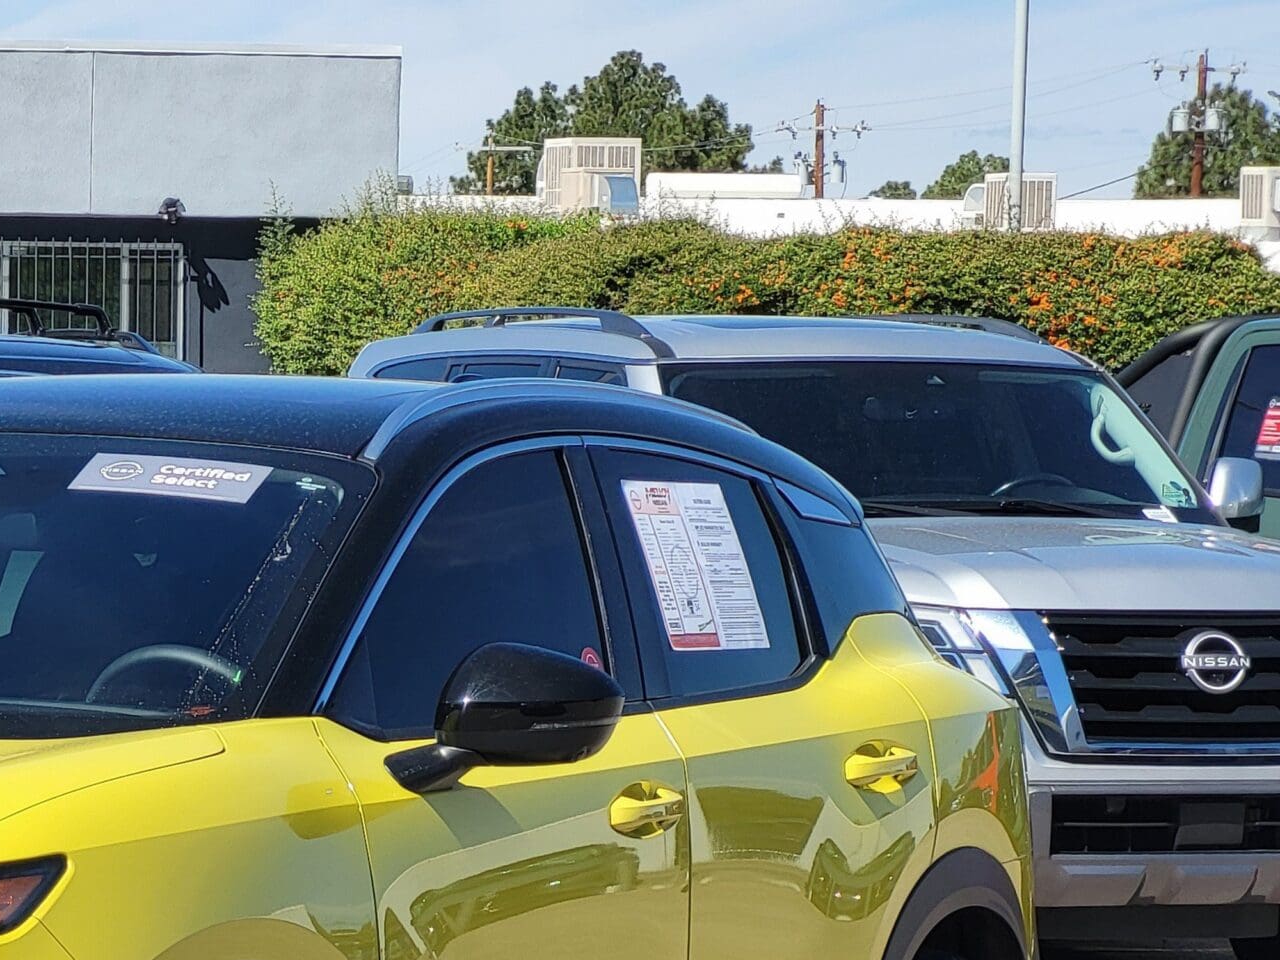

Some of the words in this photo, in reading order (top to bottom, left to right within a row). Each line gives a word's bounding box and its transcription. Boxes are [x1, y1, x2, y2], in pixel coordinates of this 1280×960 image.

[100, 466, 144, 476] NISSAN
[160, 464, 252, 482] Certified
[150, 473, 218, 489] Select
[1183, 657, 1250, 667] NISSAN
